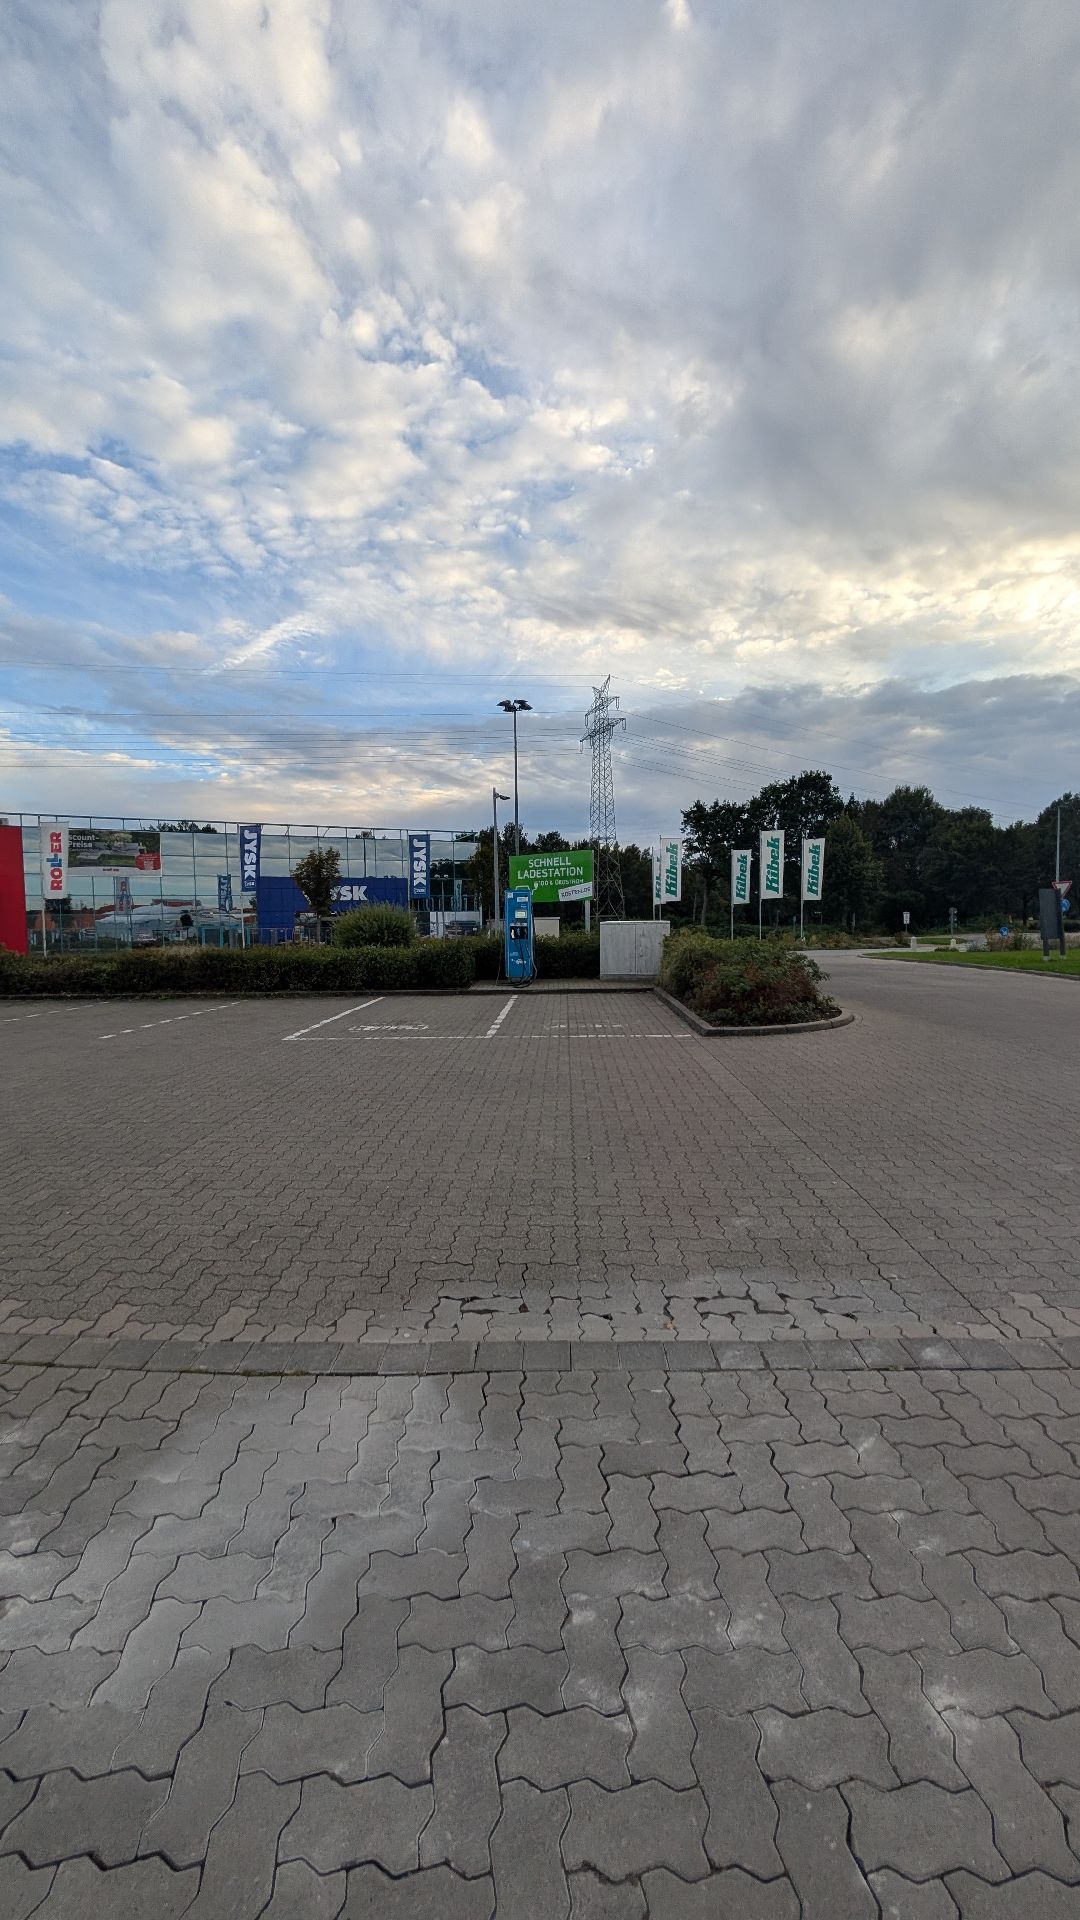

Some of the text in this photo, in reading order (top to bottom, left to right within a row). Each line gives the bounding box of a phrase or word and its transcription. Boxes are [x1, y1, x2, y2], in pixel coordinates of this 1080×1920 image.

[46, 832, 62, 890] ROLLER
[244, 830, 257, 879] JYSK
[413, 839, 427, 886] JYSK
[518, 867, 583, 879] LADESTATION
[528, 857, 571, 868] SCHNELL
[665, 842, 678, 897] Kibek
[736, 854, 748, 900] Kibek
[765, 836, 780, 894] Kibek
[807, 843, 820, 896] Kibek
